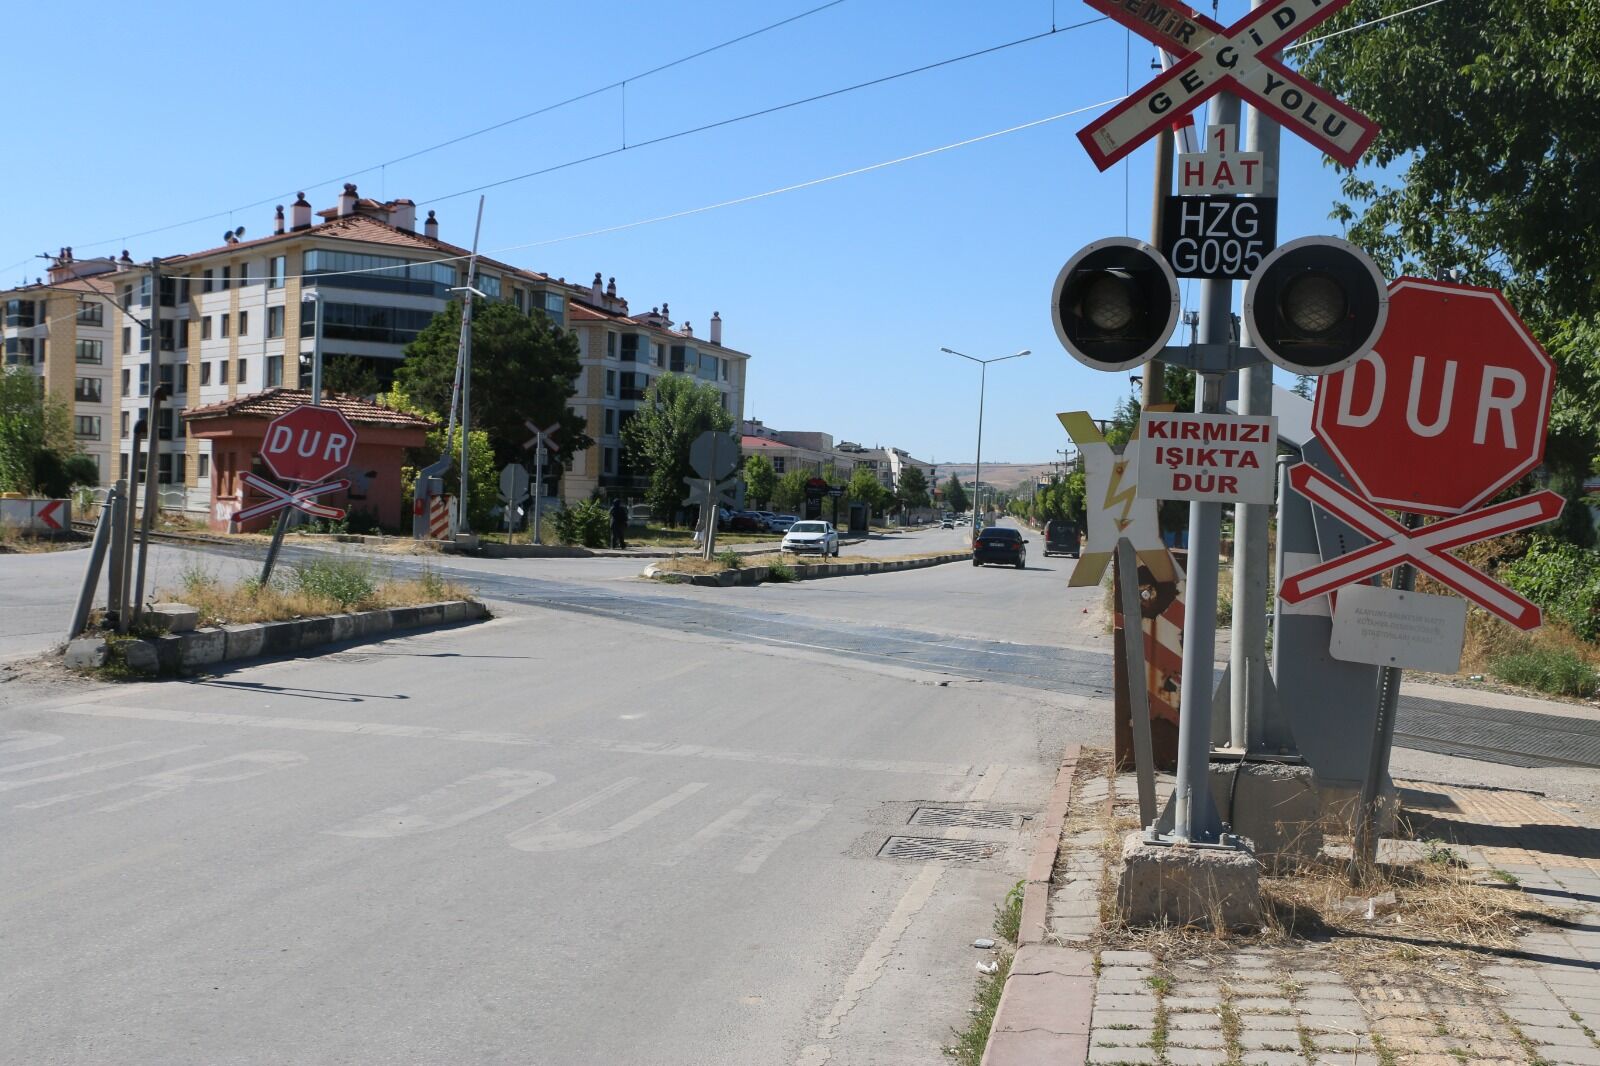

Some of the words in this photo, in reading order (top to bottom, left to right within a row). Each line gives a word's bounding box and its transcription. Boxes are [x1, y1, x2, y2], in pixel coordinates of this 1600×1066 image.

[1110, 0, 1198, 44] EMİR
[1263, 73, 1348, 138] YOLU
[1214, 128, 1226, 152] 1
[1184, 160, 1259, 187] HAT
[1180, 202, 1258, 238] HZG
[1172, 237, 1263, 275] G095
[1336, 349, 1527, 450] DUR
[269, 425, 348, 461] DUR
[1147, 420, 1270, 443] KIRMIZI
[1155, 446, 1259, 470] IŞIKTA
[1172, 473, 1238, 494] DUR
